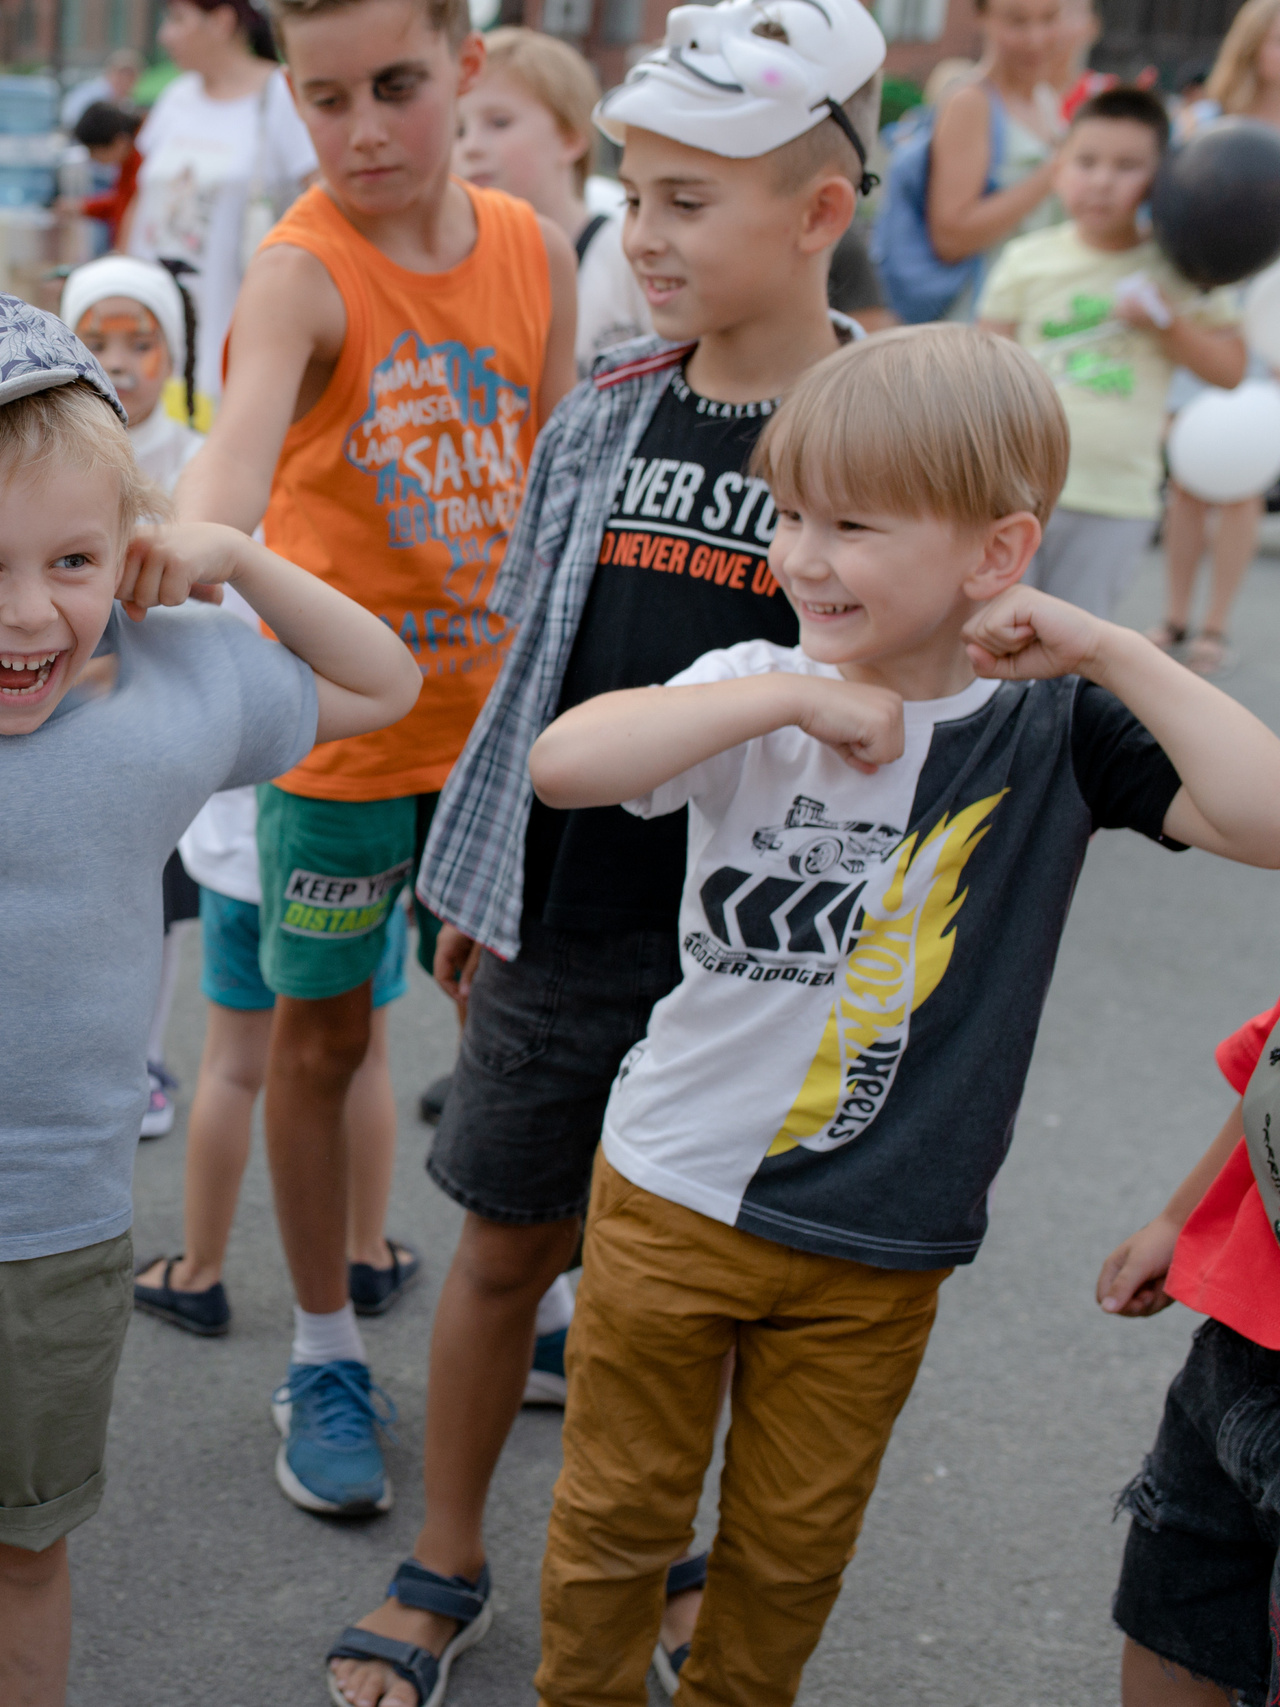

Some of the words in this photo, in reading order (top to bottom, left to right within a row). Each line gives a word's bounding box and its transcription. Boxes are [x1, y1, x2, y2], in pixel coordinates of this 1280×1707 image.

[612, 532, 690, 575] NEVER
[688, 545, 753, 590] GIVE
[291, 876, 357, 903] KEEP
